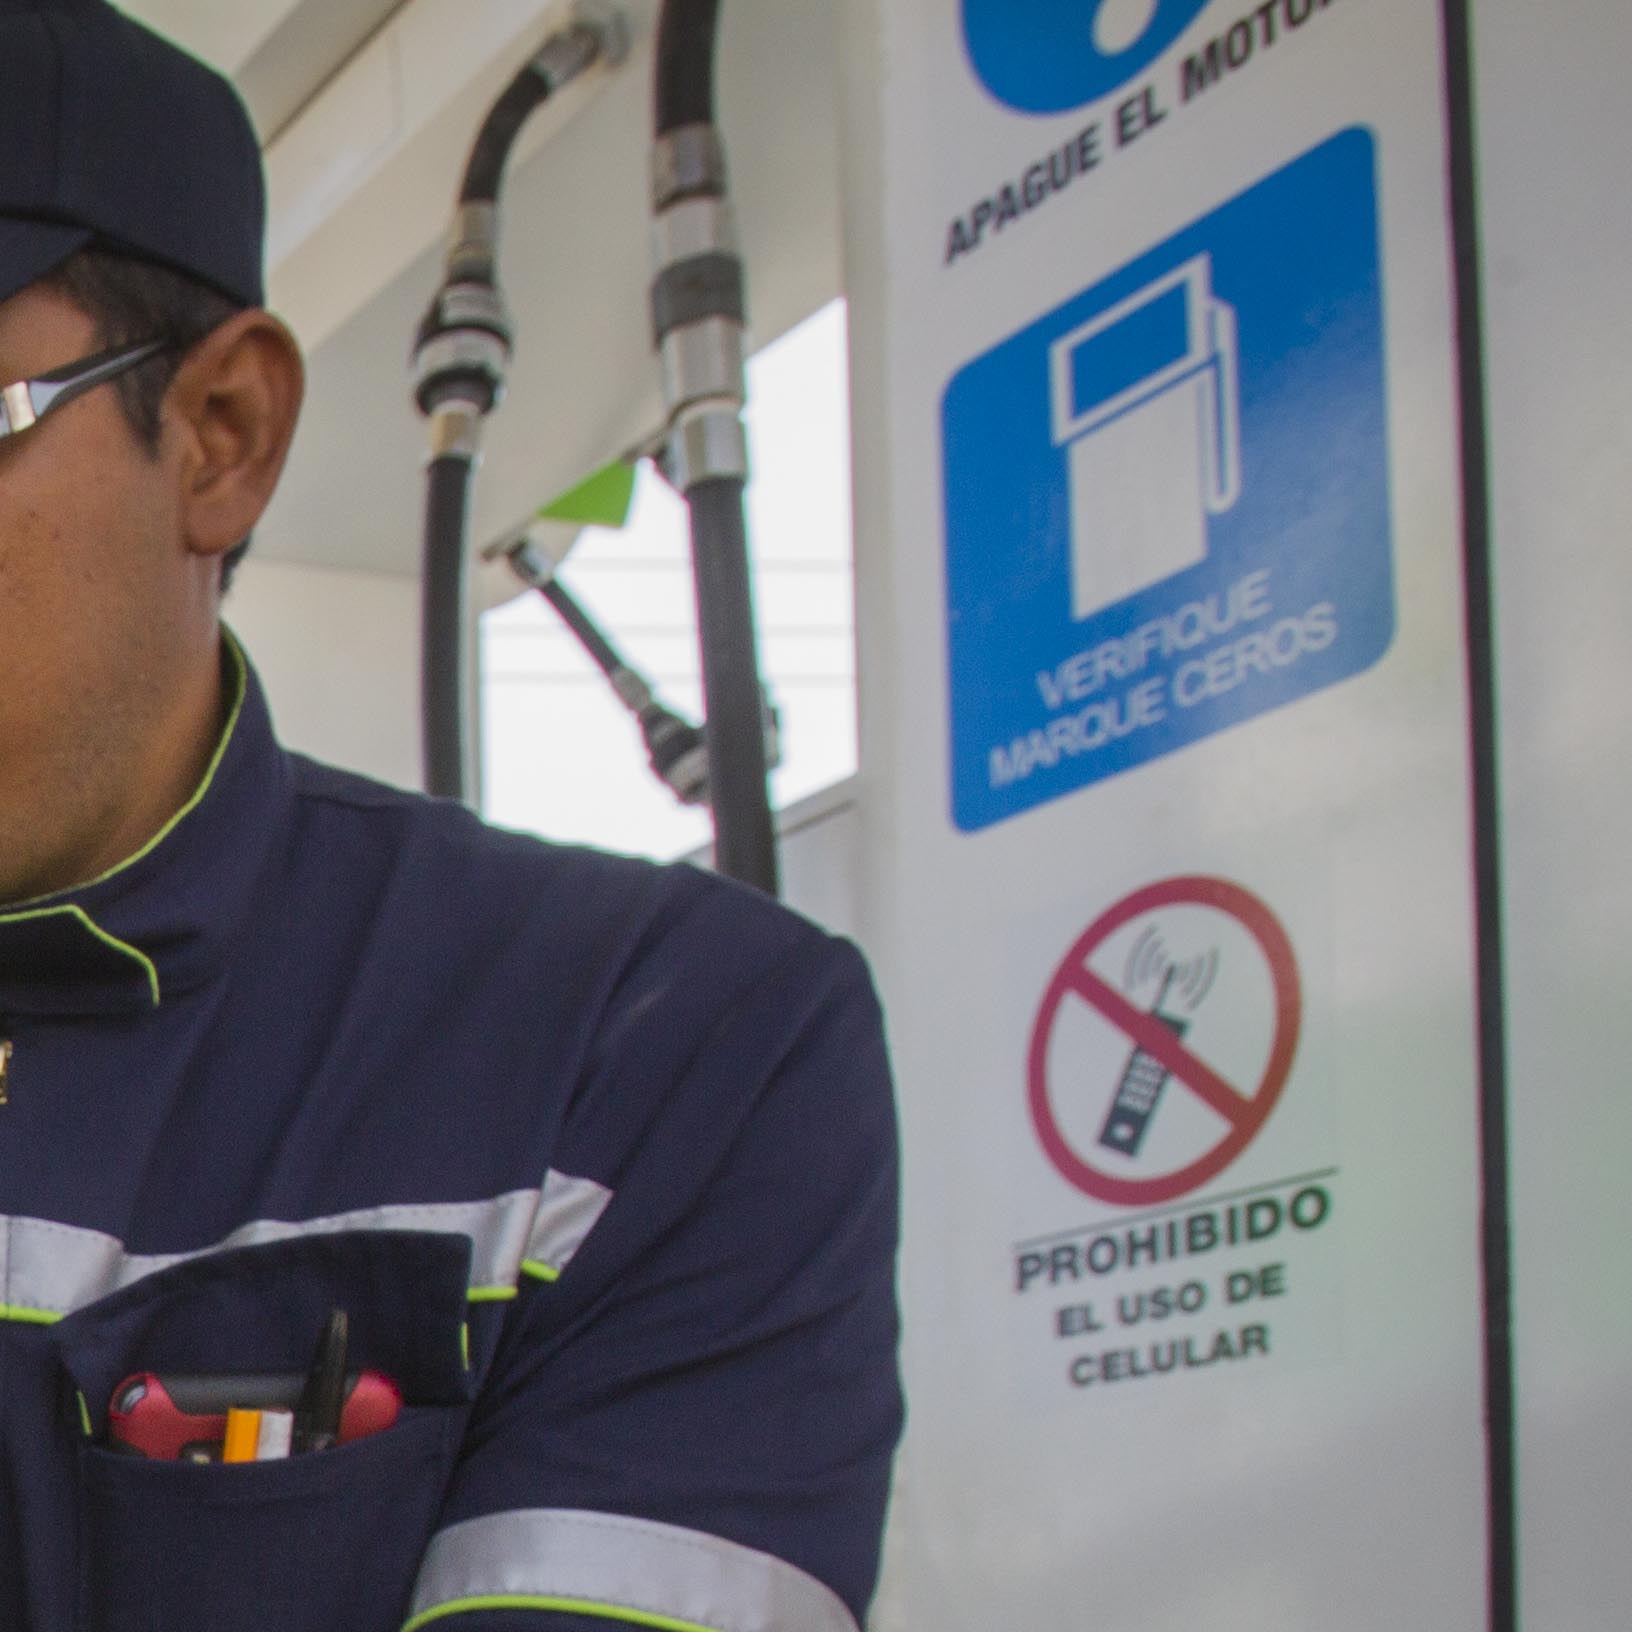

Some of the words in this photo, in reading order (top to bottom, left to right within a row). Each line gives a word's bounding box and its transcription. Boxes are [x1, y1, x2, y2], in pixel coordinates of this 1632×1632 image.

[943, 124, 1102, 267] APAGUE
[1114, 86, 1167, 151] EL
[1177, 0, 1335, 104] MOTO
[987, 685, 1168, 789] MARQUE
[1171, 601, 1339, 708] CEROS
[1037, 567, 1273, 709] VERIFIQUE
[1013, 1184, 1332, 1294] PROHIBIDO
[1056, 1303, 1102, 1338] EL
[1116, 1282, 1207, 1327] USO
[1226, 1262, 1287, 1303] DE
[1069, 1324, 1271, 1388] CELULAR
